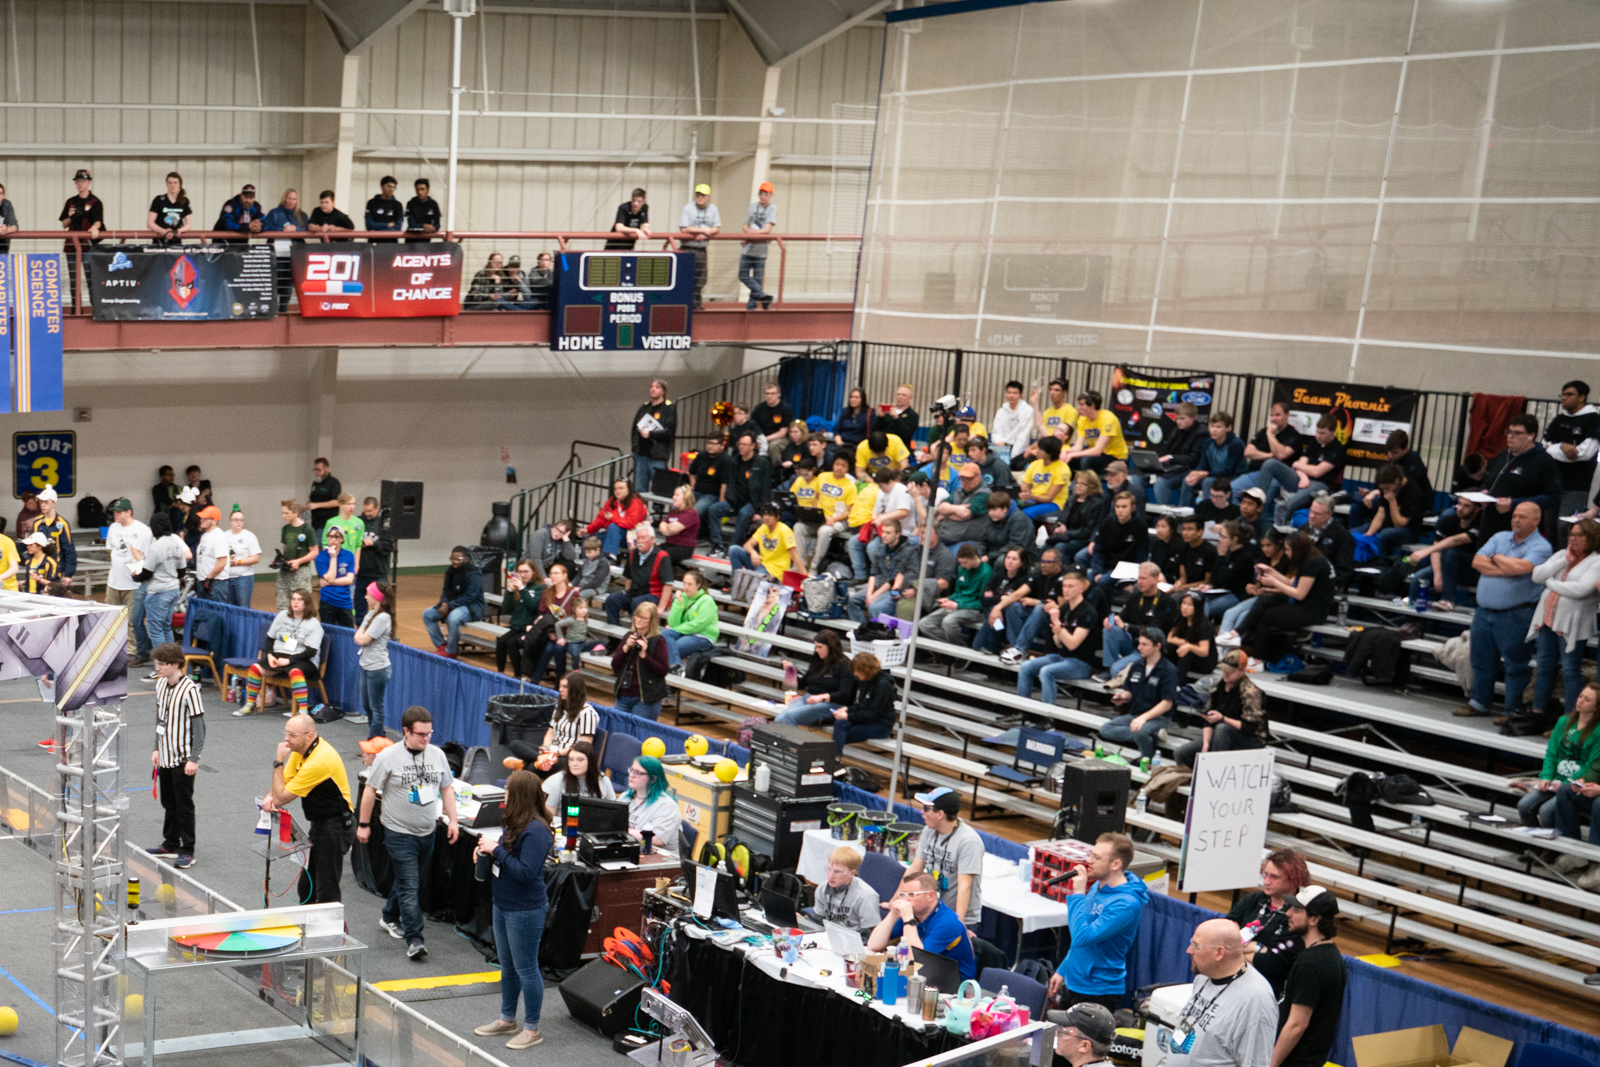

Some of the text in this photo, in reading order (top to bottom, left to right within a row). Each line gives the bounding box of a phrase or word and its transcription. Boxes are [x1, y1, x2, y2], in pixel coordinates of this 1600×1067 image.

[306, 254, 360, 281] 201
[392, 254, 451, 267] AGENTS
[411, 272, 433, 285] OF
[30, 260, 45, 318] SCIENCE
[45, 259, 60, 334] COMPUTER
[393, 287, 452, 301] CHANGE
[609, 292, 644, 303] BONUS
[609, 314, 642, 323] PERIOD
[558, 336, 691, 350] HOME VISITOR
[1293, 387, 1391, 413] Team Phoenix
[17, 438, 73, 456] COURT
[31, 456, 59, 489] 3
[401, 772, 439, 785] RECHRGE
[1206, 762, 1271, 789] WATCH
[1209, 798, 1255, 820] YOUR
[1195, 824, 1249, 852] STEP
